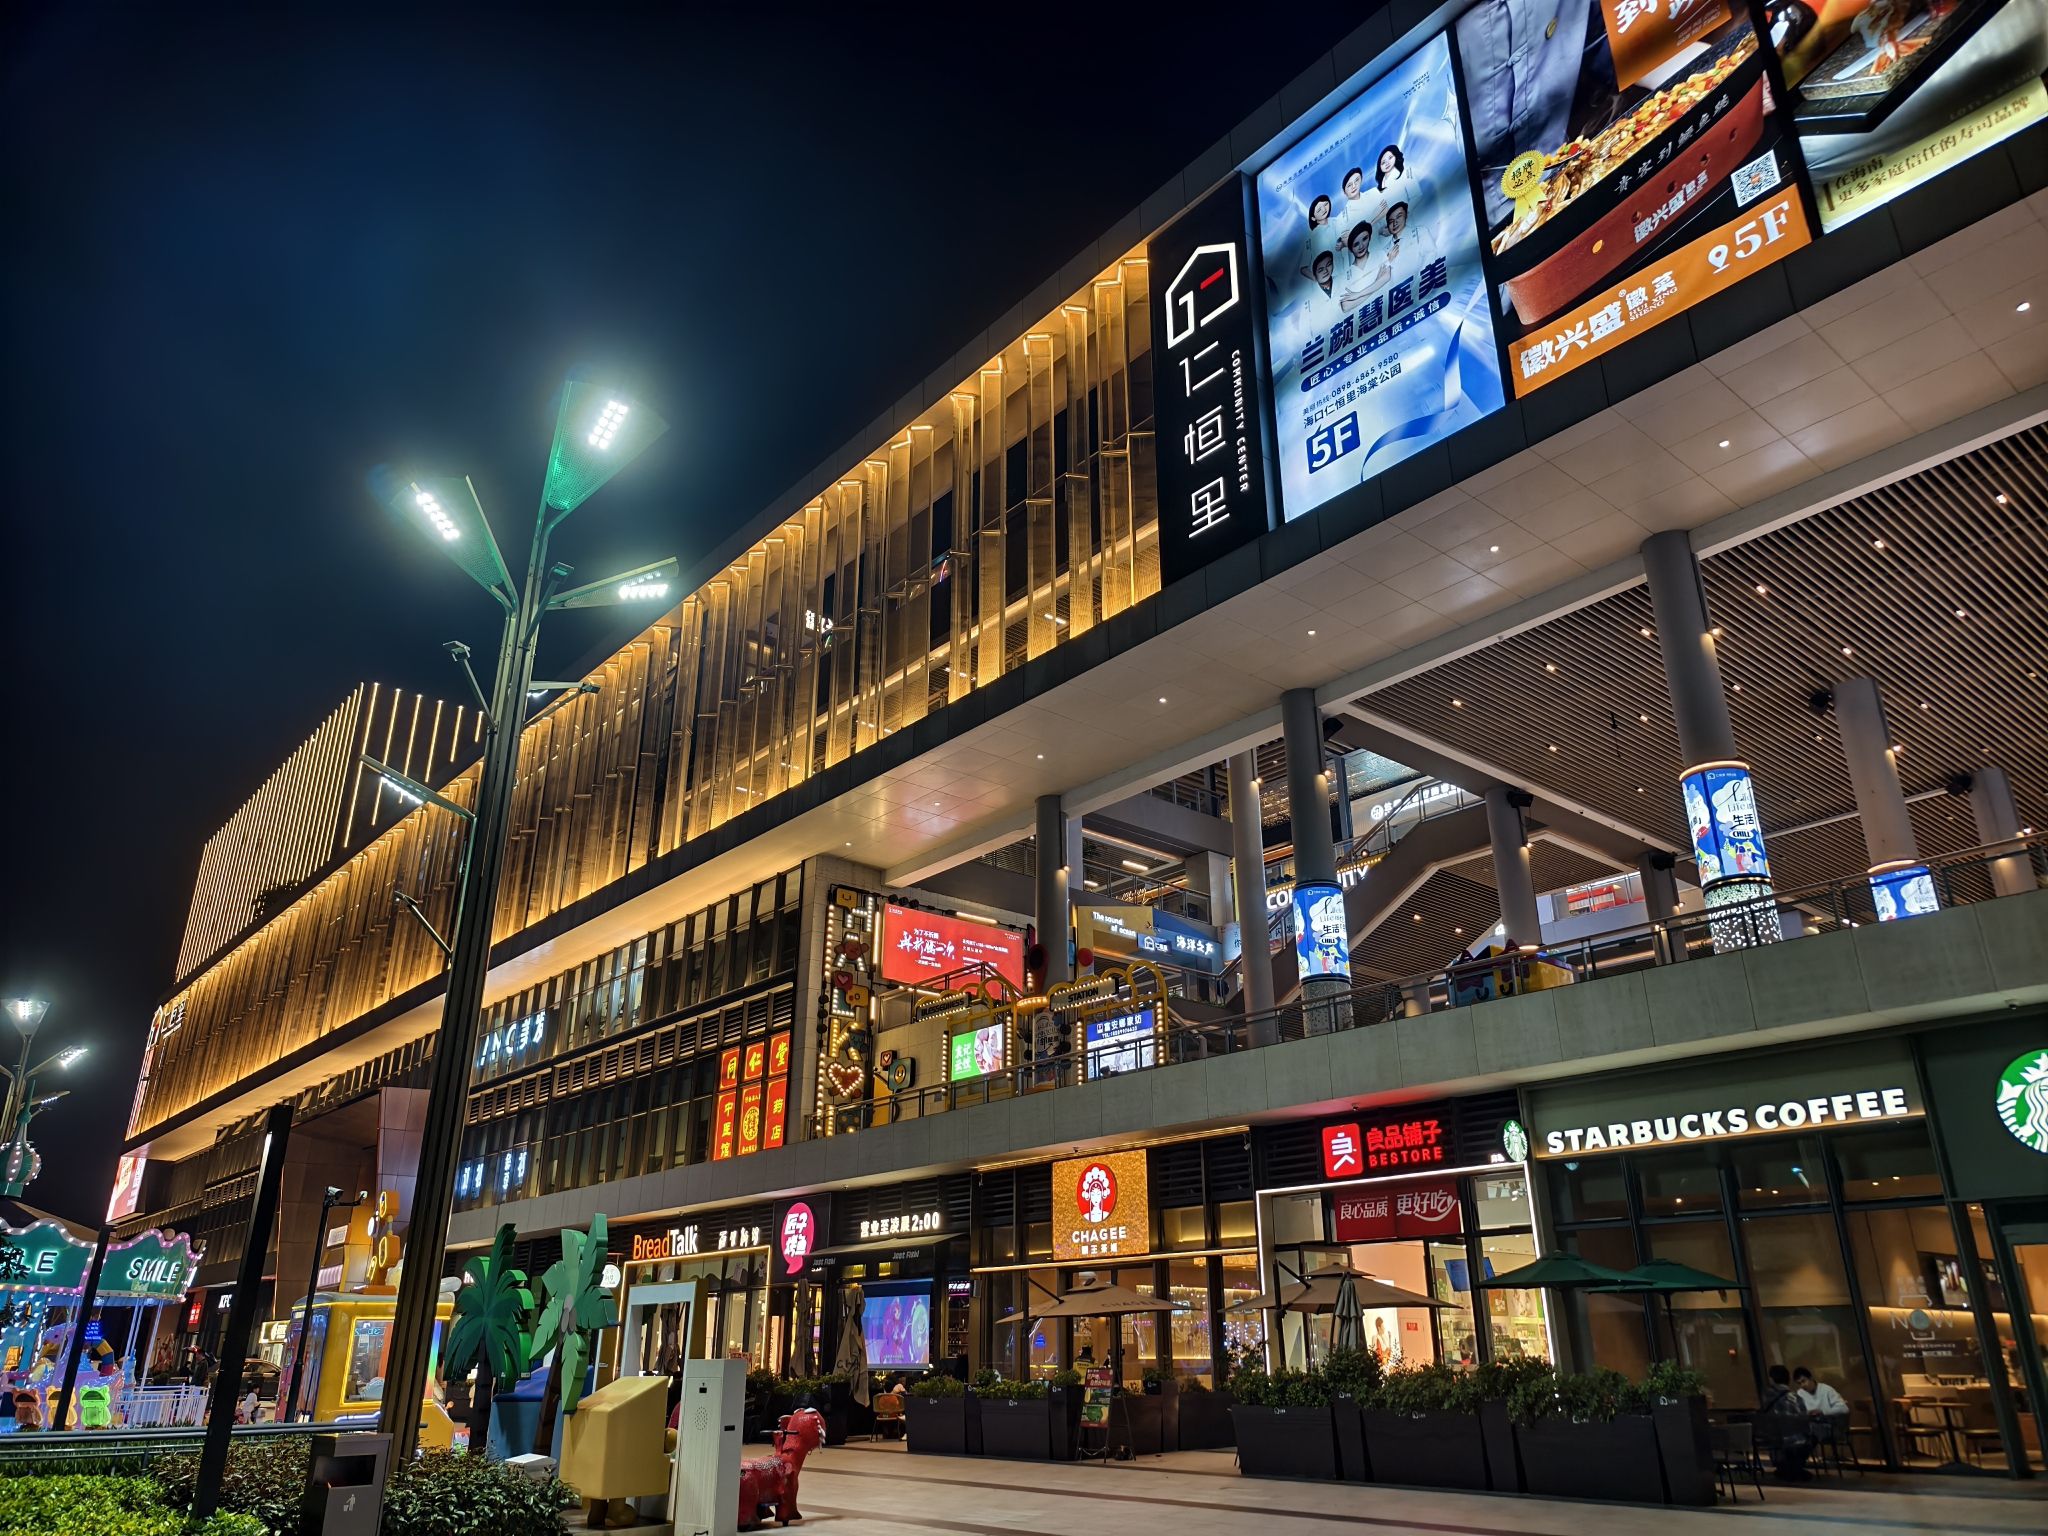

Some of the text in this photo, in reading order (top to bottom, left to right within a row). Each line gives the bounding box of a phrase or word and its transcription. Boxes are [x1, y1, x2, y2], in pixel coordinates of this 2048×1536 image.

[1511, 159, 1535, 181] 招牌
[1735, 200, 1790, 260] 5F
[1231, 349, 1249, 492] COMMUNITY CENTER
[1178, 340, 1231, 539] 仁恒里
[1312, 416, 1353, 468] 5F
[1092, 911, 1124, 926] The sound
[1176, 935, 1214, 955] 海洋之声
[1068, 986, 1099, 1003] STATION
[1547, 1088, 1909, 1154] STARBUCKS COFFEE
[1366, 1120, 1442, 1152] 良品铺子
[1368, 1146, 1443, 1167] BESTORE
[1340, 1189, 1456, 1221] 良心品质 更好吃
[632, 1224, 699, 1260] BreadTalk
[1071, 1225, 1128, 1244] CHAGEE
[127, 1257, 184, 1284] SMILE
[218, 1294, 232, 1309] KFC
